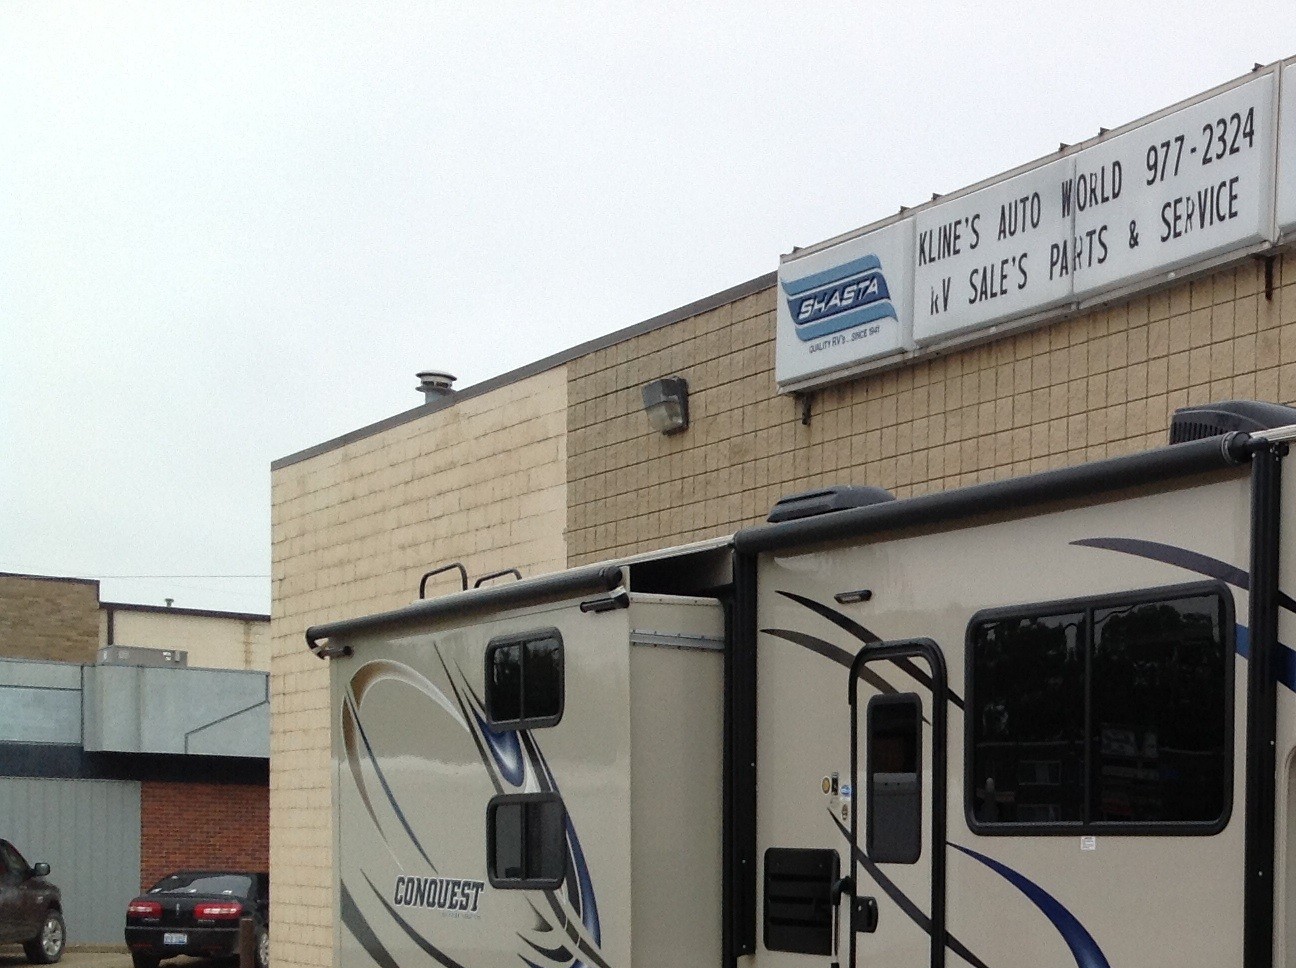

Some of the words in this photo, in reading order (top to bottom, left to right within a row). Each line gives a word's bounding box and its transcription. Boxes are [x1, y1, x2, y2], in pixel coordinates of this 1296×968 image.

[918, 213, 981, 267] KLINE'S
[998, 192, 1041, 241] AUTO
[1061, 160, 1123, 219] WORLD
[1146, 106, 1256, 187] 977-2324
[968, 252, 1028, 305] SALE'S
[1049, 224, 1109, 281] PARTS
[1128, 219, 1139, 250] &
[1160, 175, 1240, 243] SERVICE
[797, 276, 879, 321] SHASTA
[393, 876, 485, 912] CONQUEST
